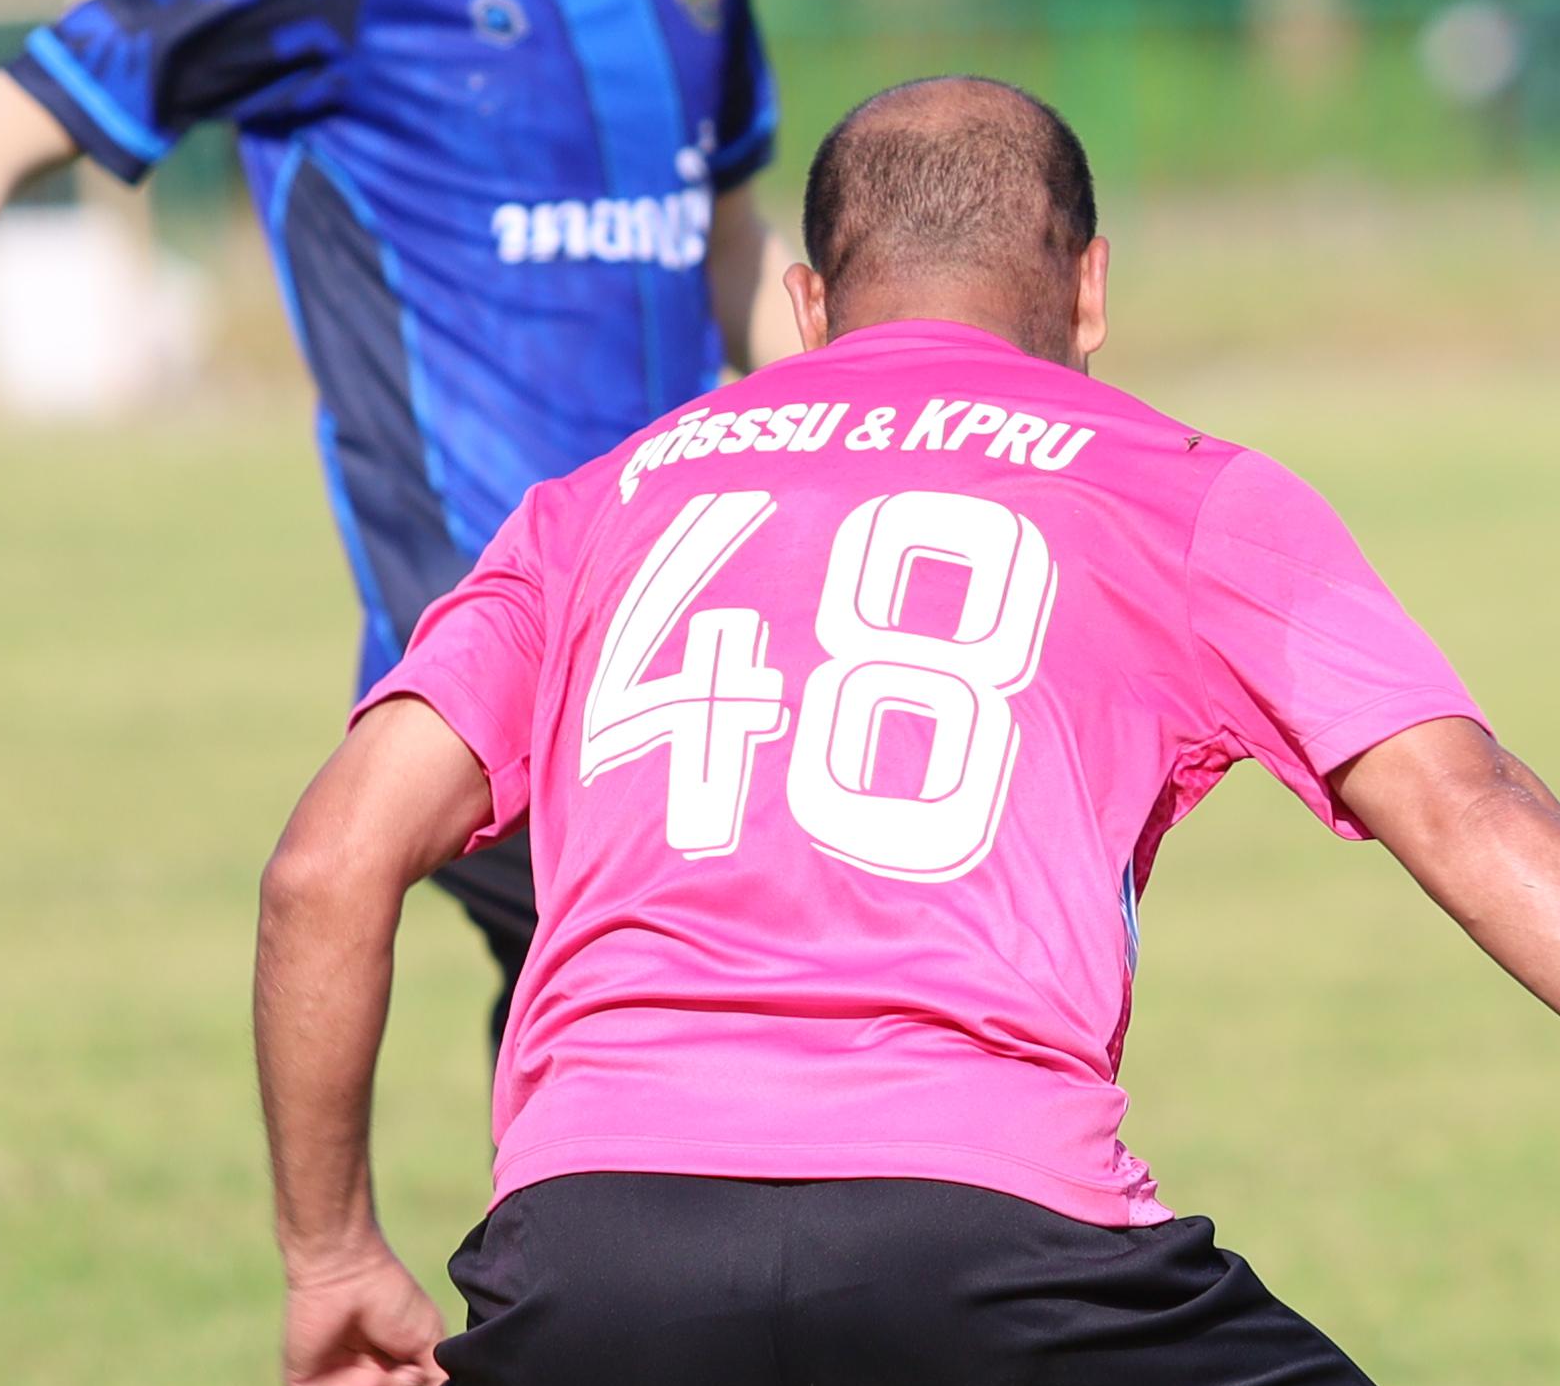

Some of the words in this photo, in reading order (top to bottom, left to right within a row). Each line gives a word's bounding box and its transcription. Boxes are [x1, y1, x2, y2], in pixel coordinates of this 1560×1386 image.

[844, 406, 897, 451] &
[900, 398, 1097, 471] KPRU
[579, 490, 1058, 884] 48
